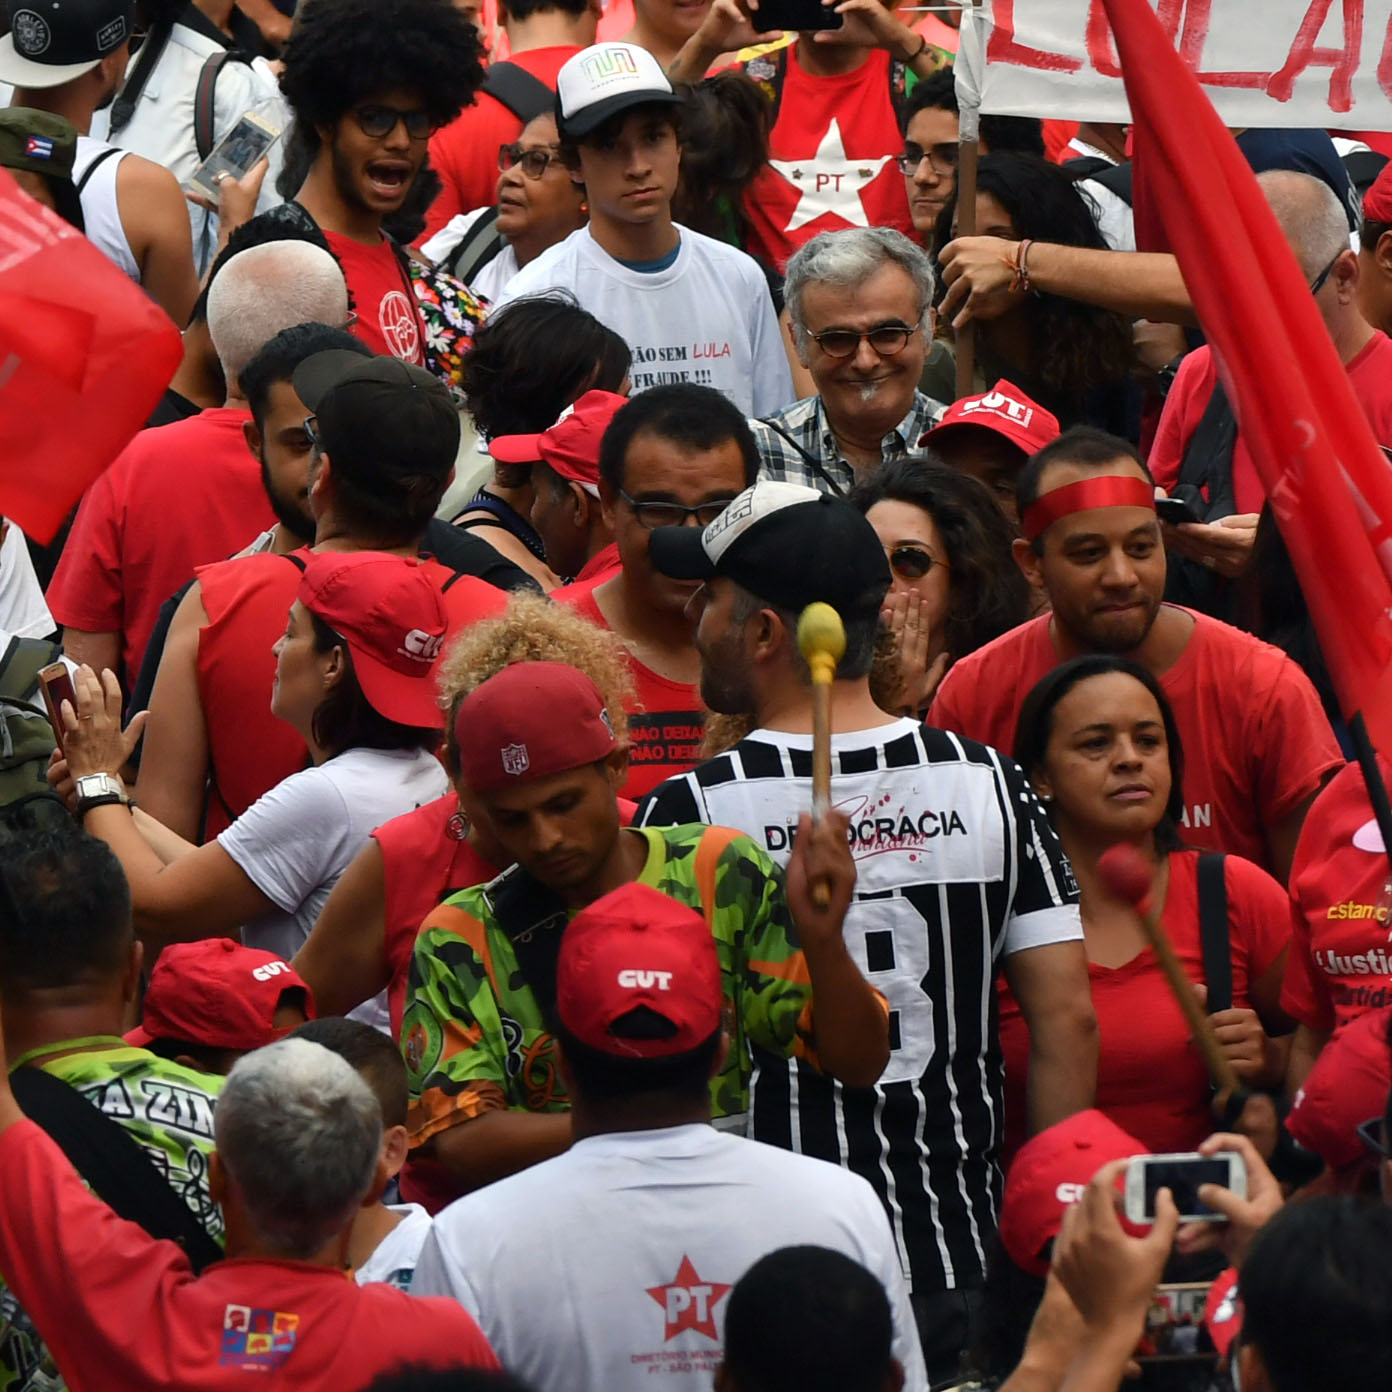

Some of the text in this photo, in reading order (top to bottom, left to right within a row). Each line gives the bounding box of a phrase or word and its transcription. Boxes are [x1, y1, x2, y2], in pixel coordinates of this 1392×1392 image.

[815, 173, 844, 193] PT
[658, 346, 688, 362] SEM
[692, 342, 731, 360] LULA
[634, 371, 690, 389] FRAUDE
[629, 724, 660, 741] NÃO
[630, 743, 665, 761] NÃO
[764, 810, 968, 851] DECRACIA
[252, 960, 293, 982] CUT
[617, 969, 673, 991] CUT
[666, 1285, 713, 1324] PT
